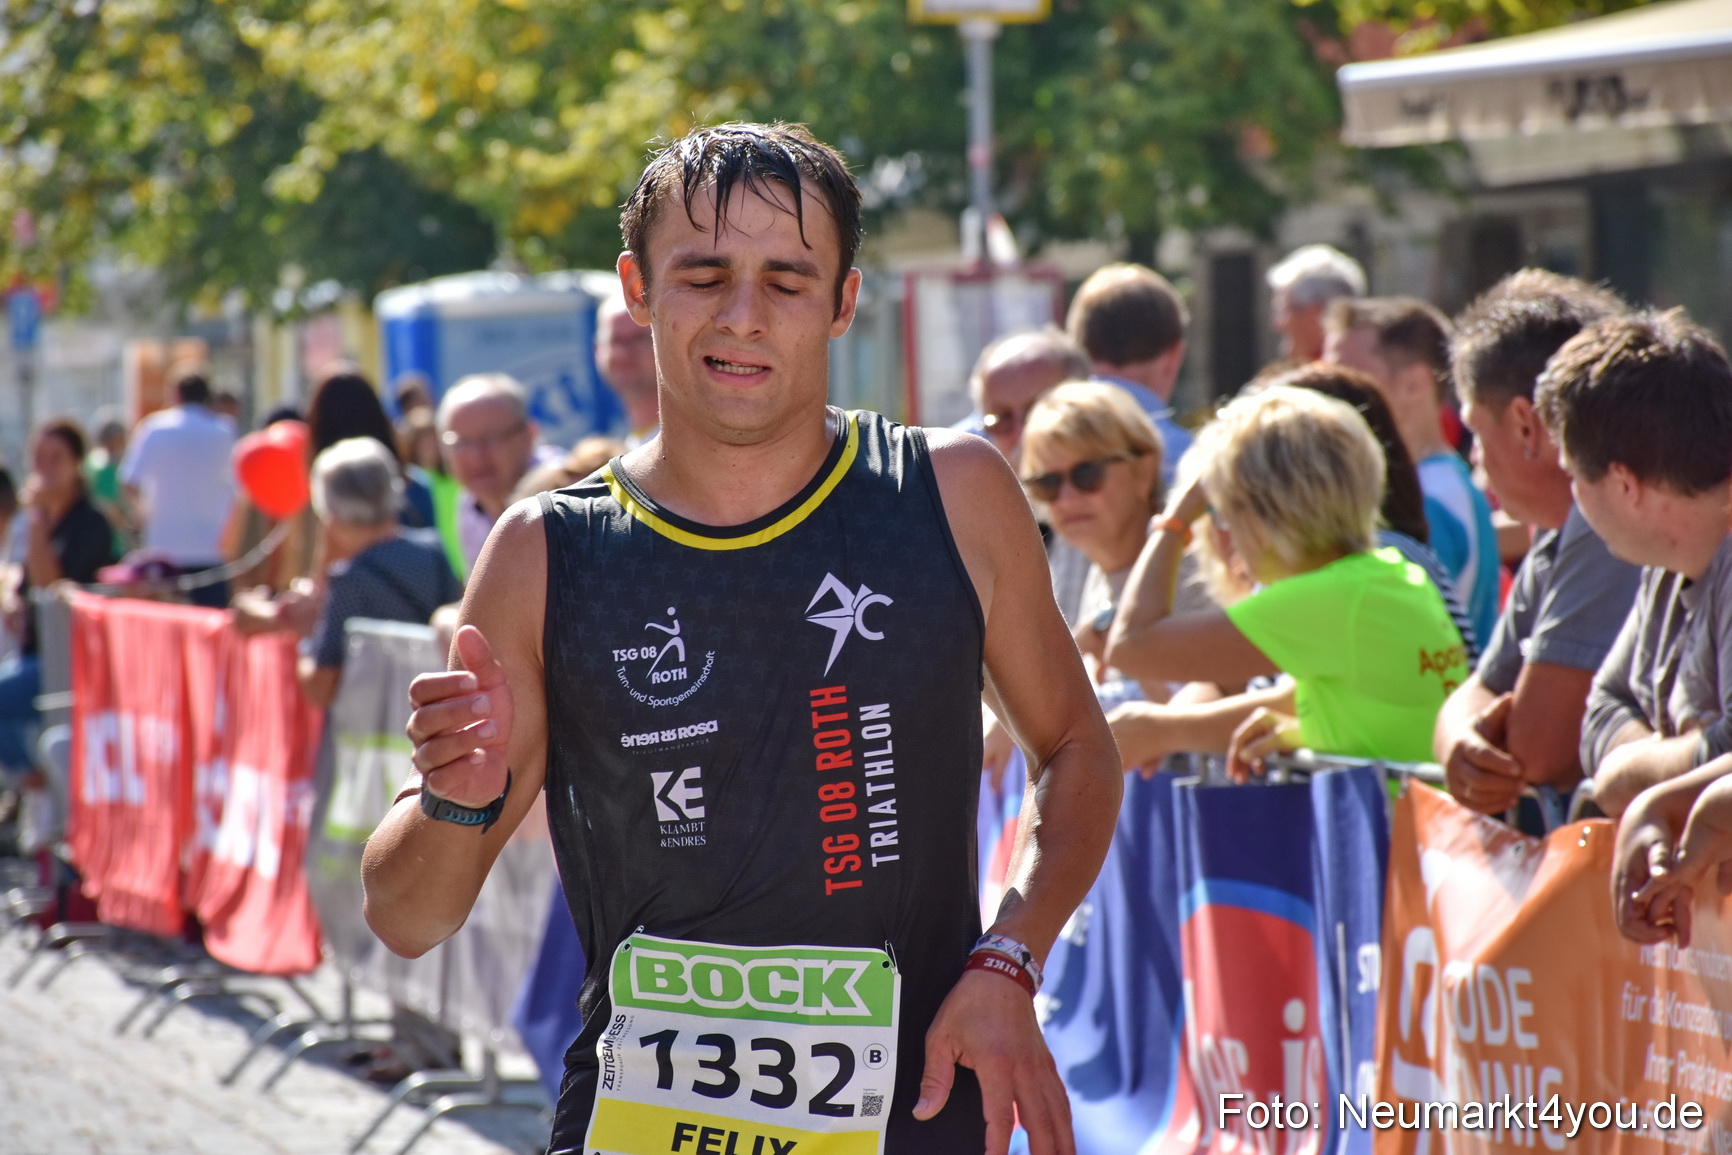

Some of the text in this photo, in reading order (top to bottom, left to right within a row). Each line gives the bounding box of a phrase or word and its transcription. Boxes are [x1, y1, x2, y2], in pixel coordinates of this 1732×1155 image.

[612, 646, 657, 662] TSG 08
[616, 650, 716, 709] Turn- und Sportgemeinschaft
[651, 667, 688, 684] ROTH
[810, 685, 863, 896] TSG 08 ROTH
[859, 703, 900, 867] TRIATHLON
[659, 821, 705, 835] KLAMBT
[660, 835, 707, 848] &ENDRES
[983, 957, 1019, 978] BIKE
[630, 947, 872, 1016] BOCK
[870, 1050, 882, 1063] B
[639, 1029, 855, 1117] 1332
[671, 1122, 798, 1155] FELIX
